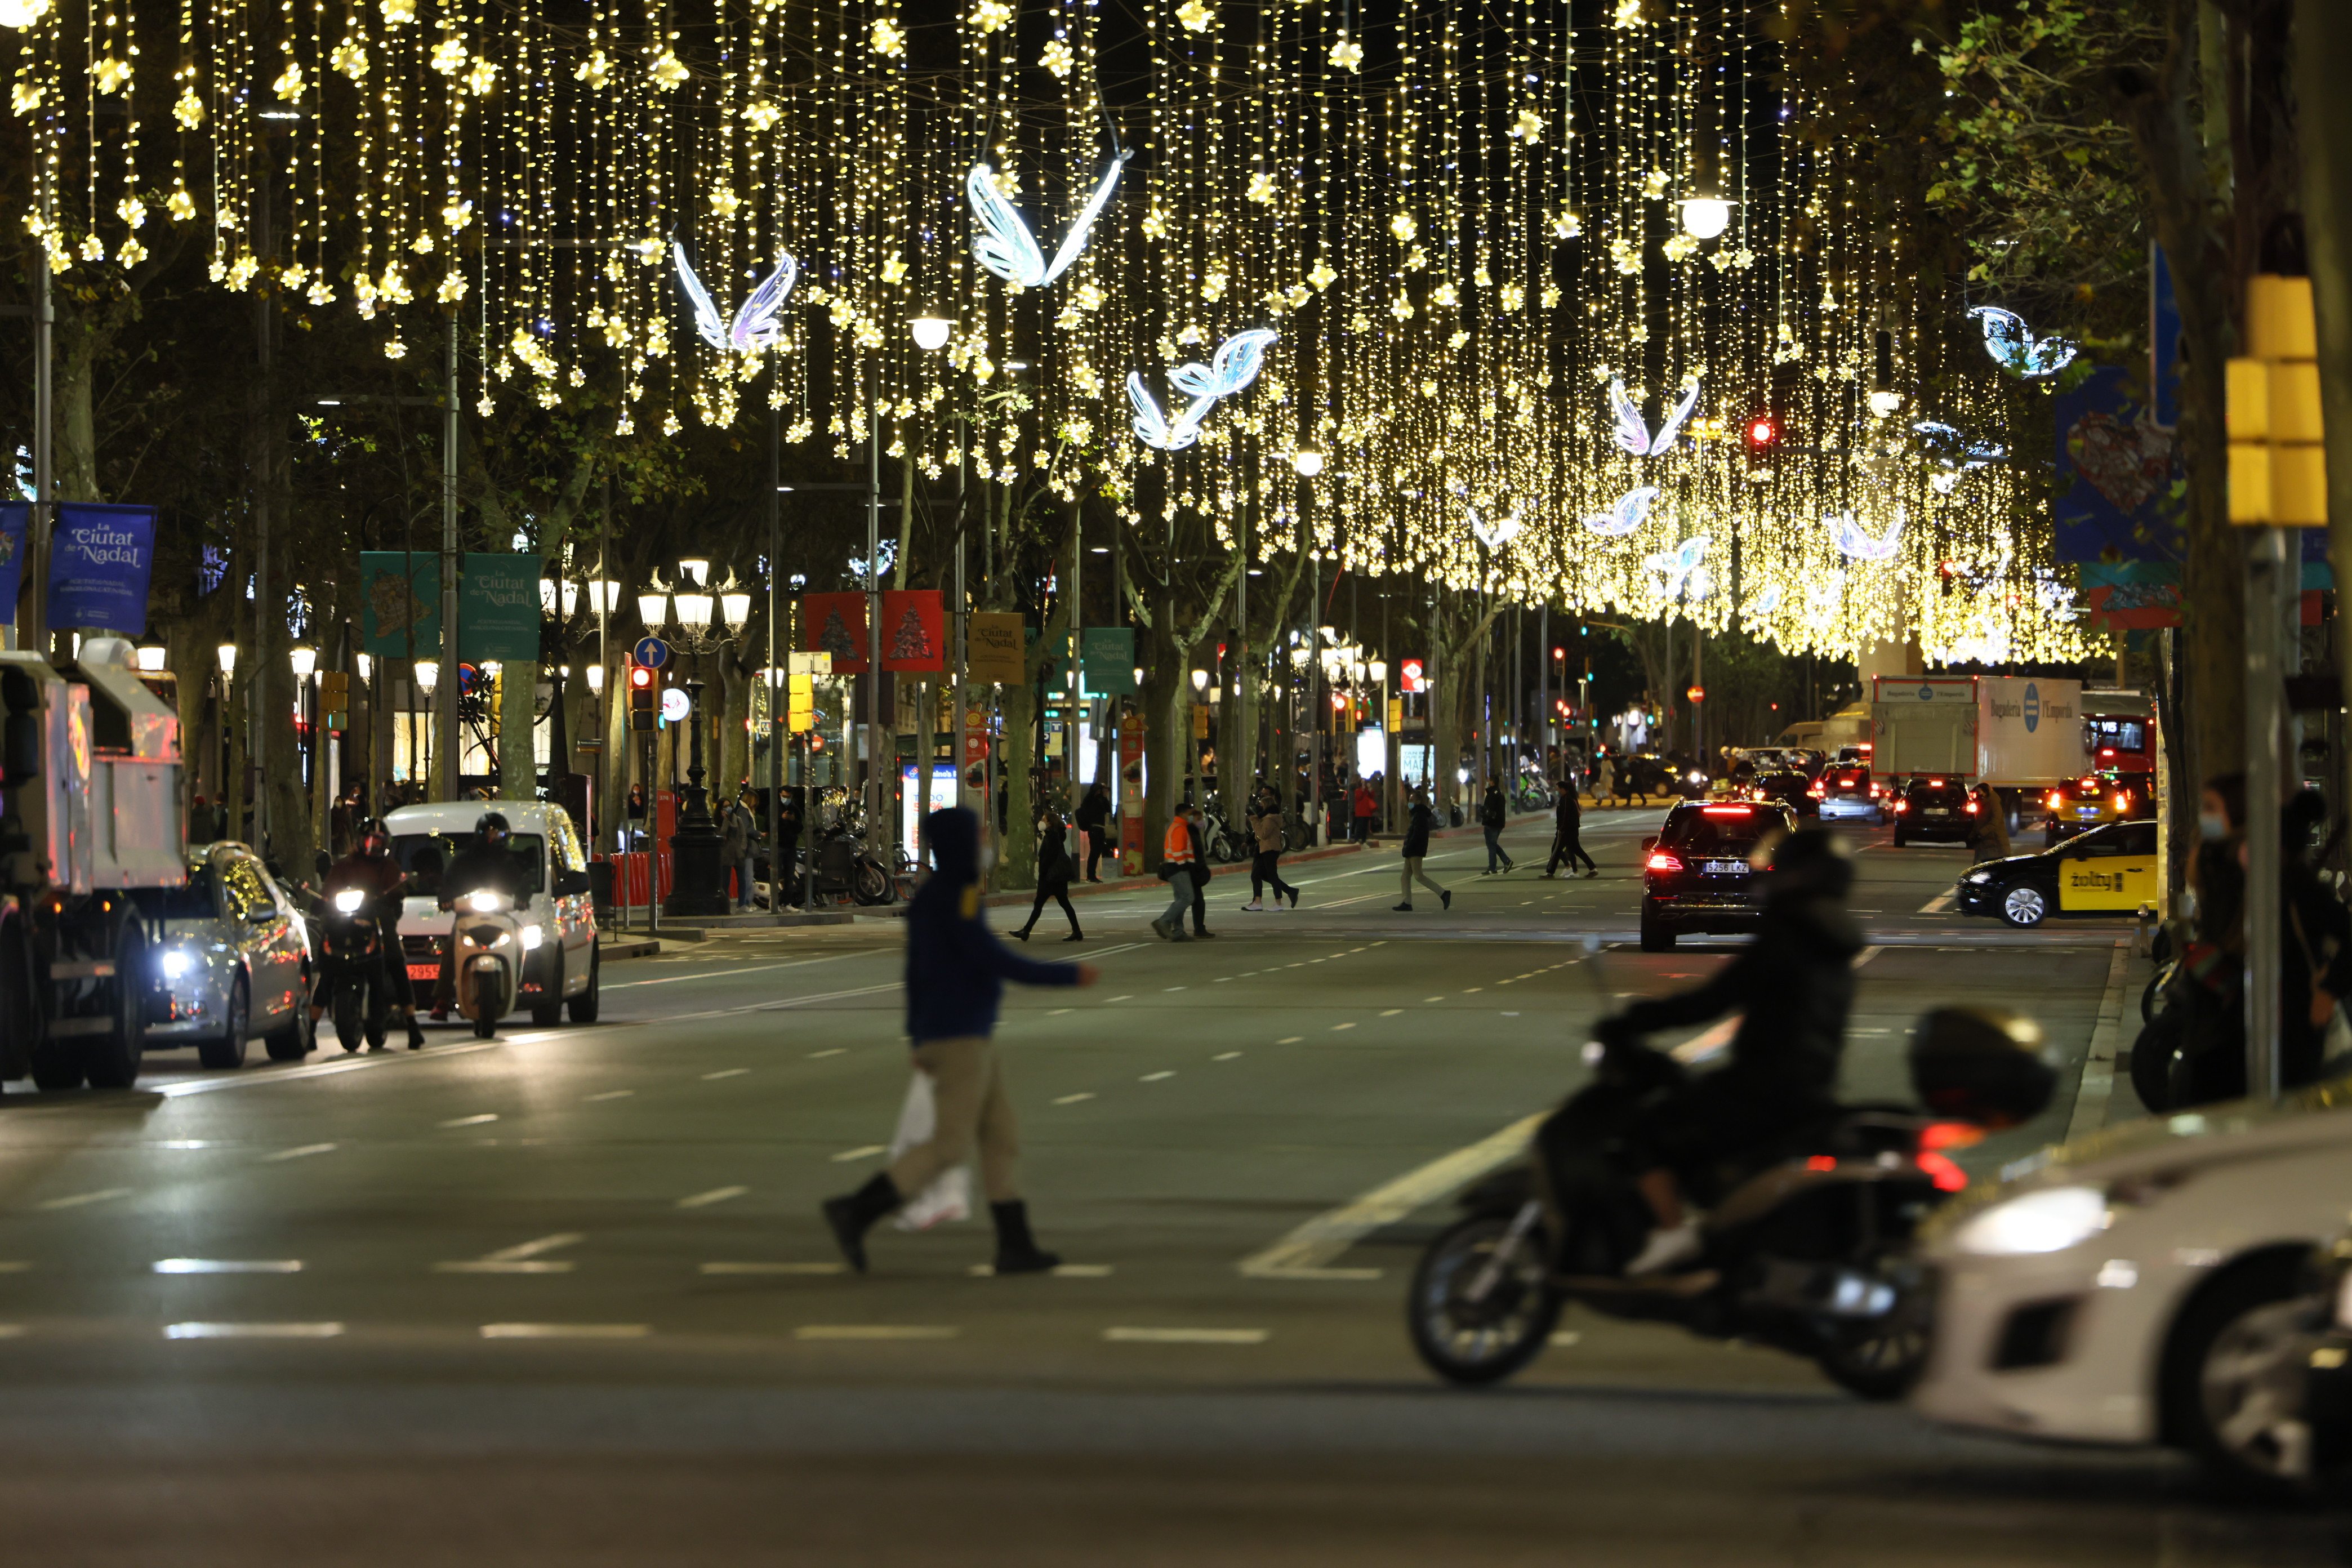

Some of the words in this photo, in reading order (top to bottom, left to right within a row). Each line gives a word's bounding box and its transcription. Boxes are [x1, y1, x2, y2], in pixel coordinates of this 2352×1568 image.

[72, 529, 134, 546] Ciutat
[65, 544, 76, 552] de
[78, 545, 141, 568] Nadal
[475, 575, 525, 590] Ciutat
[481, 590, 533, 608] Nadal
[978, 628, 1013, 638] Ciutat
[983, 638, 1018, 651] Nadal
[2101, 721, 2117, 733] V15
